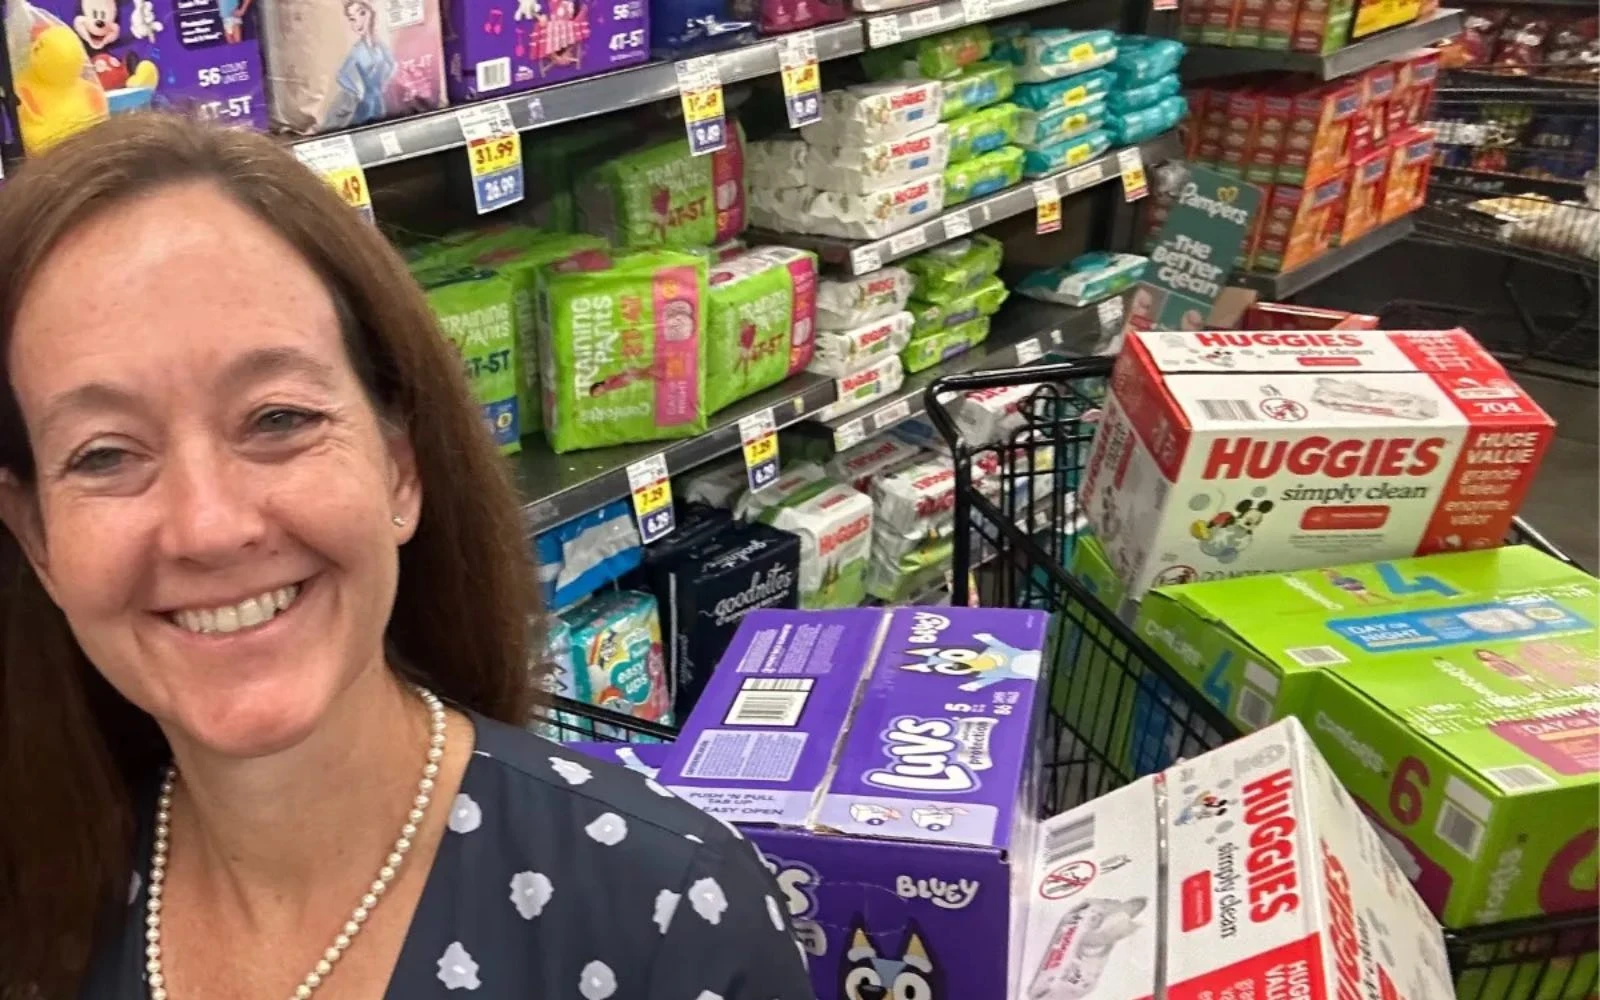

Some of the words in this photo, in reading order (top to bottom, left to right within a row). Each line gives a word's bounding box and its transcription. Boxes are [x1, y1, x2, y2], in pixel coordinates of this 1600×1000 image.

[198, 67, 221, 87] 56
[475, 140, 515, 165] 31.99
[1178, 182, 1248, 226] Pampers
[1194, 332, 1364, 347] HUGGIES
[1474, 401, 1523, 414] 704
[1475, 432, 1540, 448] HUGE
[1201, 436, 1447, 480] HUGGIES
[1467, 449, 1536, 464] VALUE
[1280, 484, 1360, 504] simply
[1365, 482, 1430, 501] clean
[714, 562, 793, 617] goodnites
[1375, 560, 1461, 598] 4
[1347, 623, 1387, 634] DAY
[944, 702, 971, 713] 5
[1389, 755, 1431, 827] 6
[741, 807, 785, 815] OPEN
[1242, 768, 1300, 924] HUGGIES
[1214, 841, 1241, 894] simply
[896, 874, 980, 909] BLUEY
[1217, 895, 1242, 940] clean
